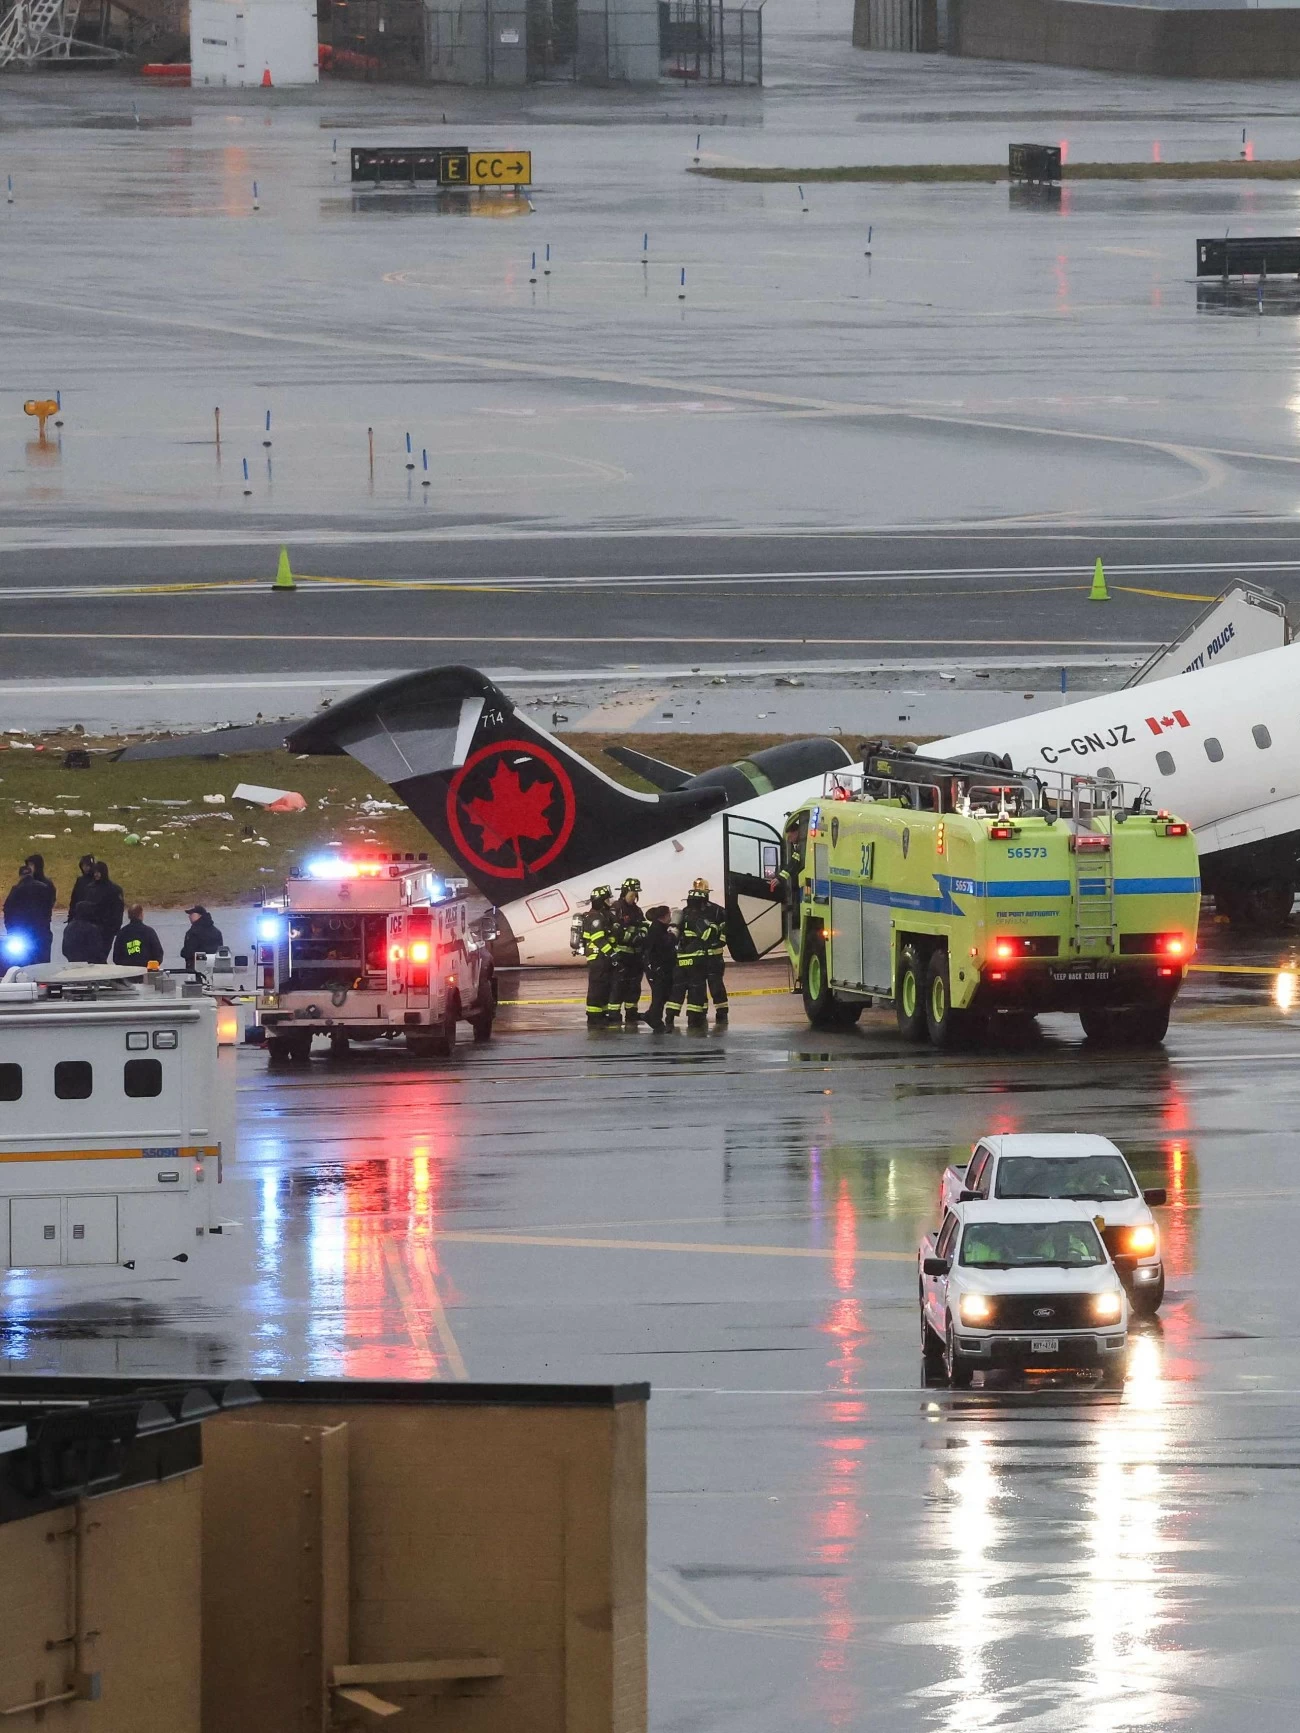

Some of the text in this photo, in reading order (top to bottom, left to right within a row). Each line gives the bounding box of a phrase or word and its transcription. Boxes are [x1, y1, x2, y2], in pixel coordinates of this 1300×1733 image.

[447, 158, 461, 179] E
[475, 158, 503, 178] CC
[1181, 621, 1236, 675] RITY POLICE
[481, 711, 504, 728] 714
[1040, 724, 1137, 764] C-GNJZ
[1007, 847, 1048, 859] 56573
[1096, 972, 1109, 980] FEET
